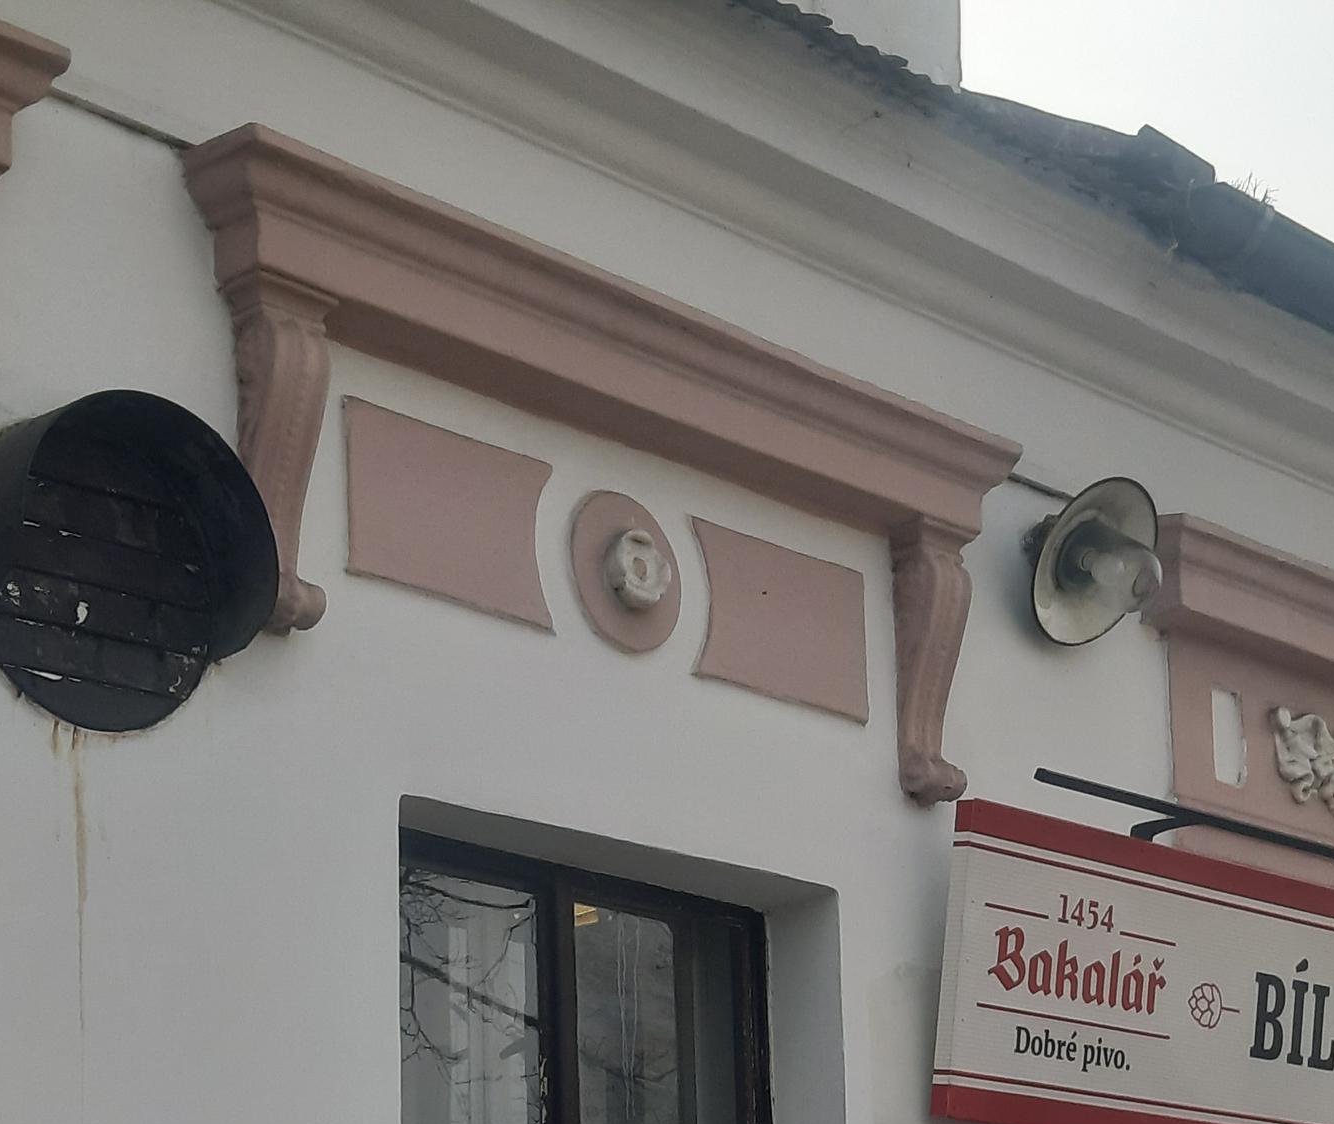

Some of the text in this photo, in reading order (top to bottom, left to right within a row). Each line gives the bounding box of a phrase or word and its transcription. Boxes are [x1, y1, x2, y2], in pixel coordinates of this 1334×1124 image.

[1056, 893, 1116, 934] 1454
[986, 925, 1168, 1016] Bakalář
[1014, 1026, 1132, 1075] Dobré pivo.
